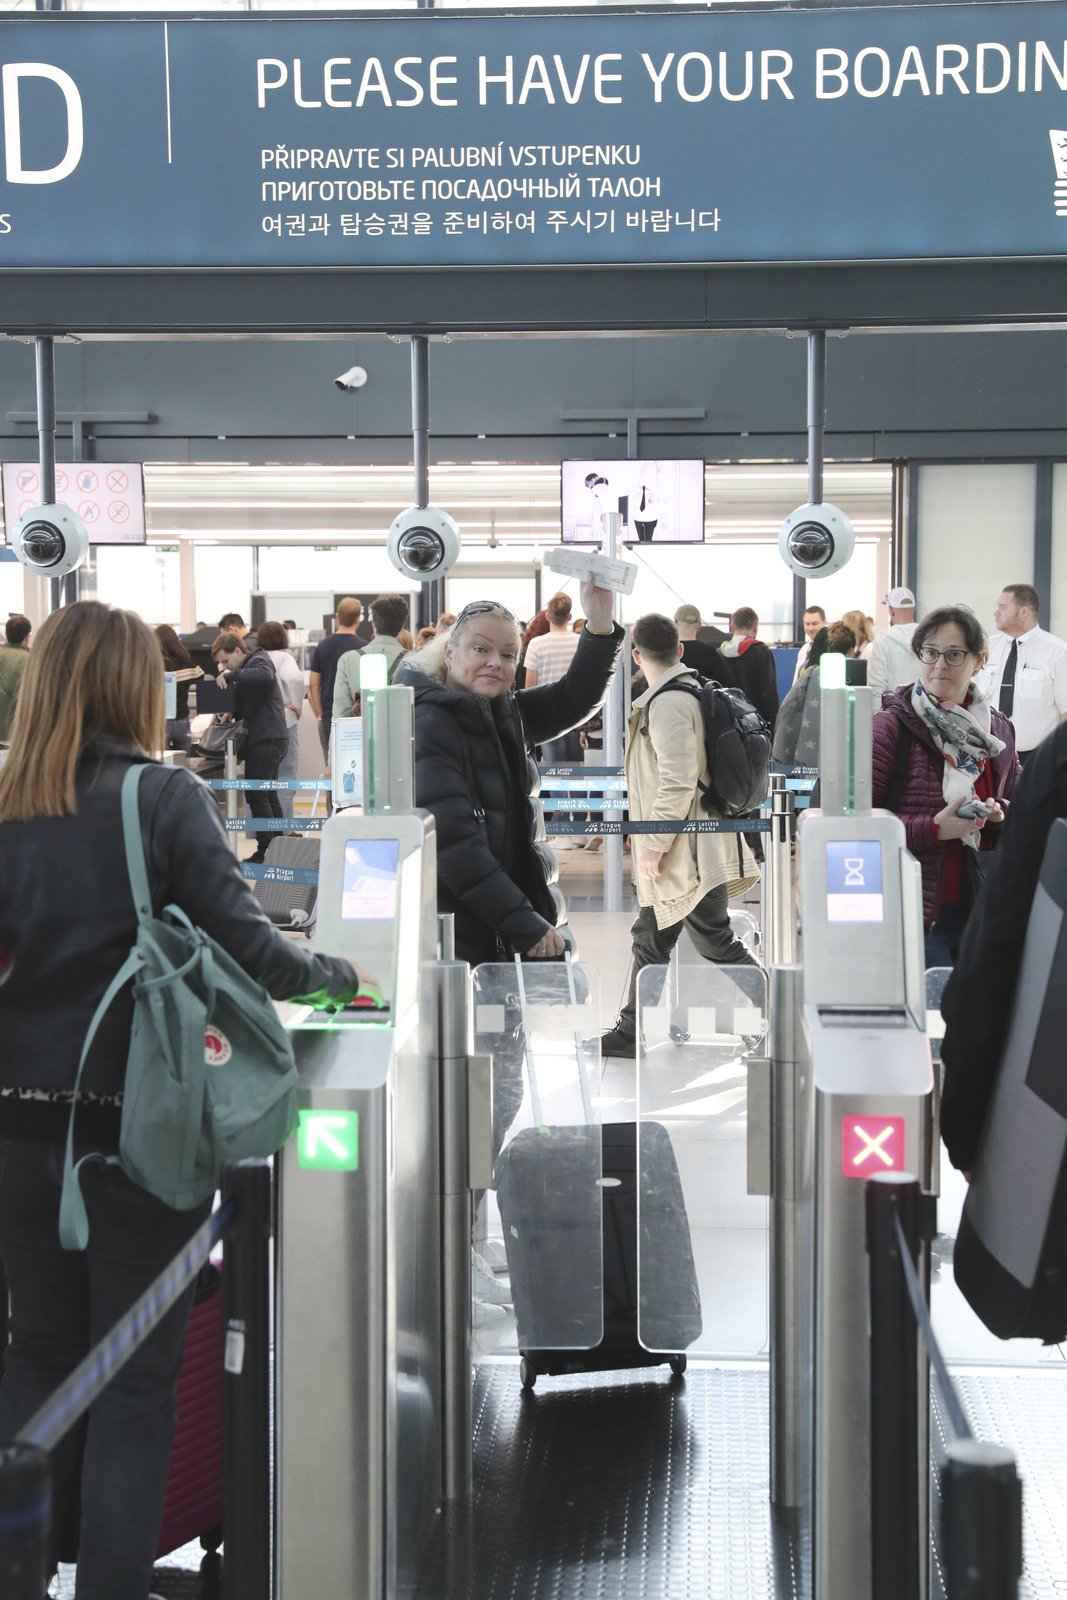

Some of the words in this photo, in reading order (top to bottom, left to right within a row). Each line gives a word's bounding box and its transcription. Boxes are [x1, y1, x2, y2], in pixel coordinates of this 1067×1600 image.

[256, 56, 458, 109] PLEASE
[478, 52, 624, 106] HAVE
[640, 49, 796, 103] YOUR
[815, 39, 1067, 100] BOARDIN
[1, 62, 84, 185] D
[261, 143, 380, 170] PŘIPRAVTE
[385, 147, 405, 169] SI
[411, 141, 504, 168] PALUBNÍ
[508, 144, 641, 168] VSTUPENKU
[261, 179, 416, 202] ПРИГОТОВЬТЕ
[421, 172, 581, 202] ПОСАДОЧНЫЙ
[586, 176, 661, 198] ТАЛОН
[261, 212, 331, 237] 여권과
[340, 211, 434, 236] 탑승권을
[442, 210, 535, 236] 준비하여
[545, 209, 615, 234] 주시기
[626, 207, 722, 234] 바랍니다
[276, 867, 294, 876] Prague
[276, 873, 294, 882] Airport
